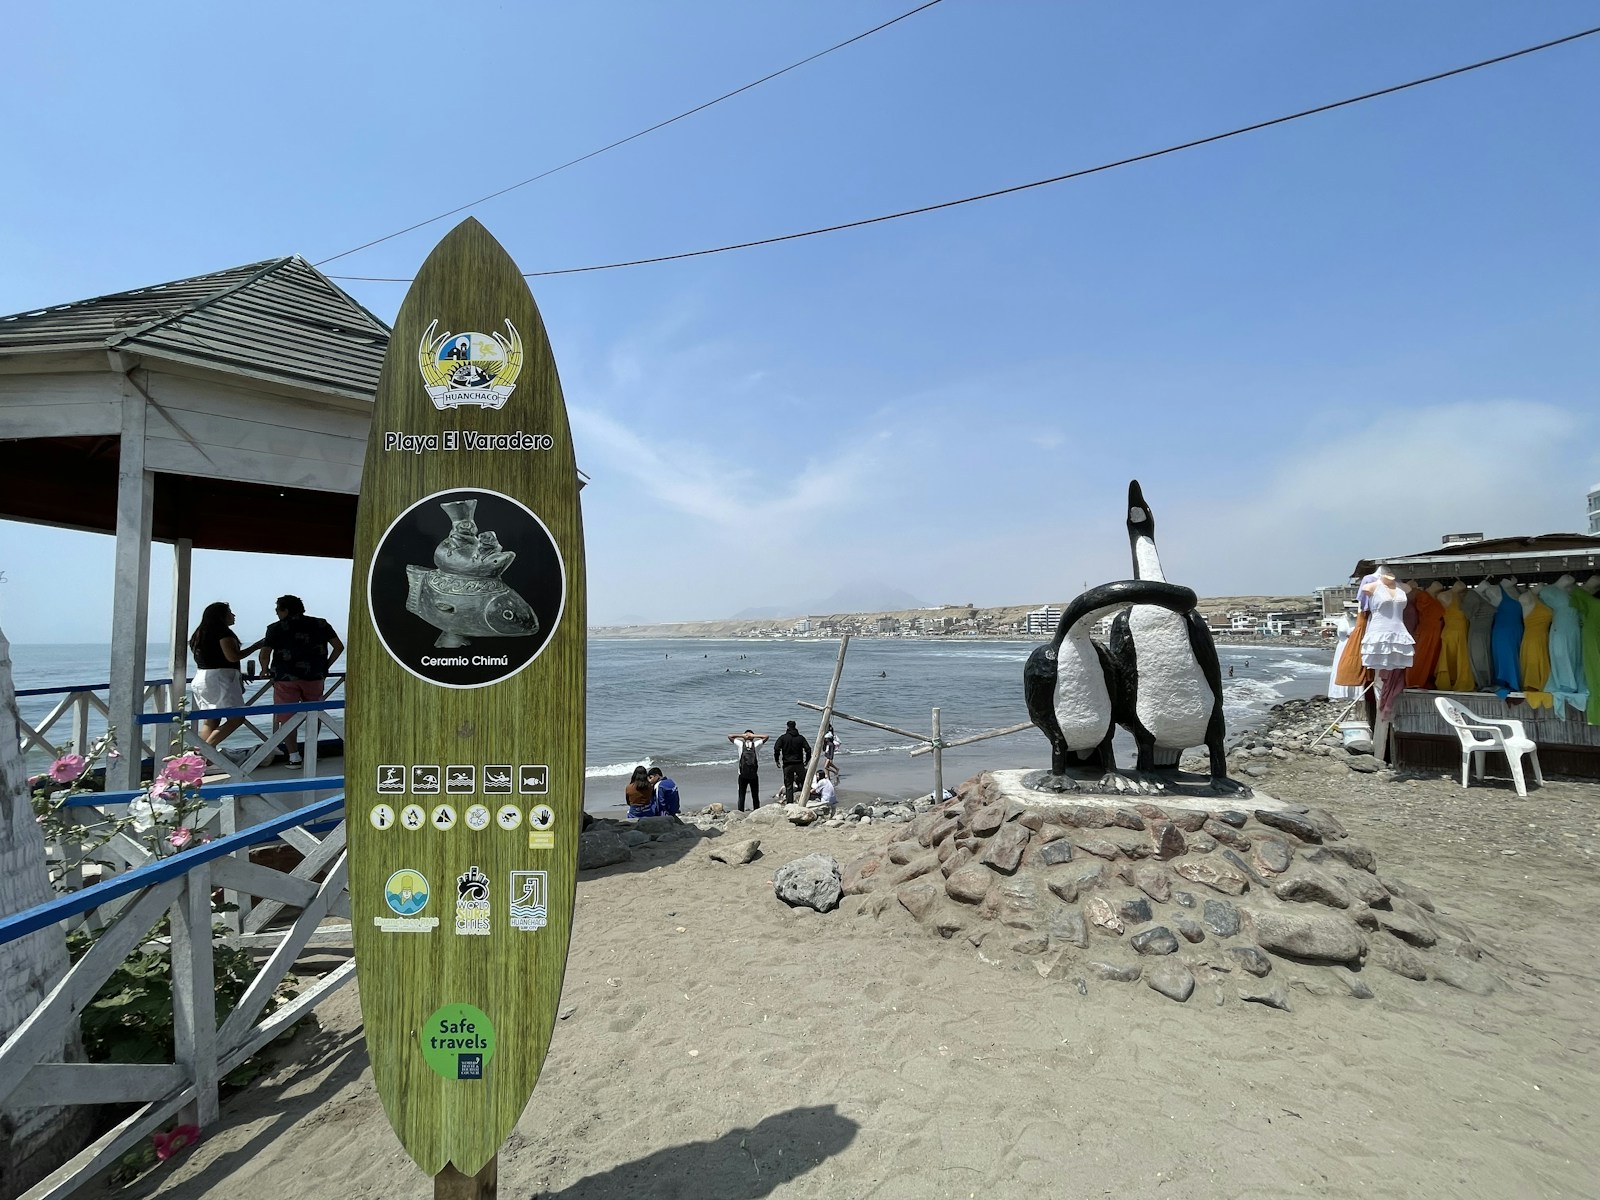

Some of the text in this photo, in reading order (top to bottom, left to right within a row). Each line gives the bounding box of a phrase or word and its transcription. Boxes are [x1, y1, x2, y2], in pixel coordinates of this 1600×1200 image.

[445, 392, 499, 401] HUANCHACO
[385, 431, 553, 453] Playa El Varadero
[421, 655, 508, 666] Ceramio Chimú
[457, 901, 489, 909] WORLD
[457, 909, 489, 919] SURF
[456, 919, 489, 929] CITIES
[440, 1018, 475, 1033] Safe
[430, 1033, 487, 1049] travels
